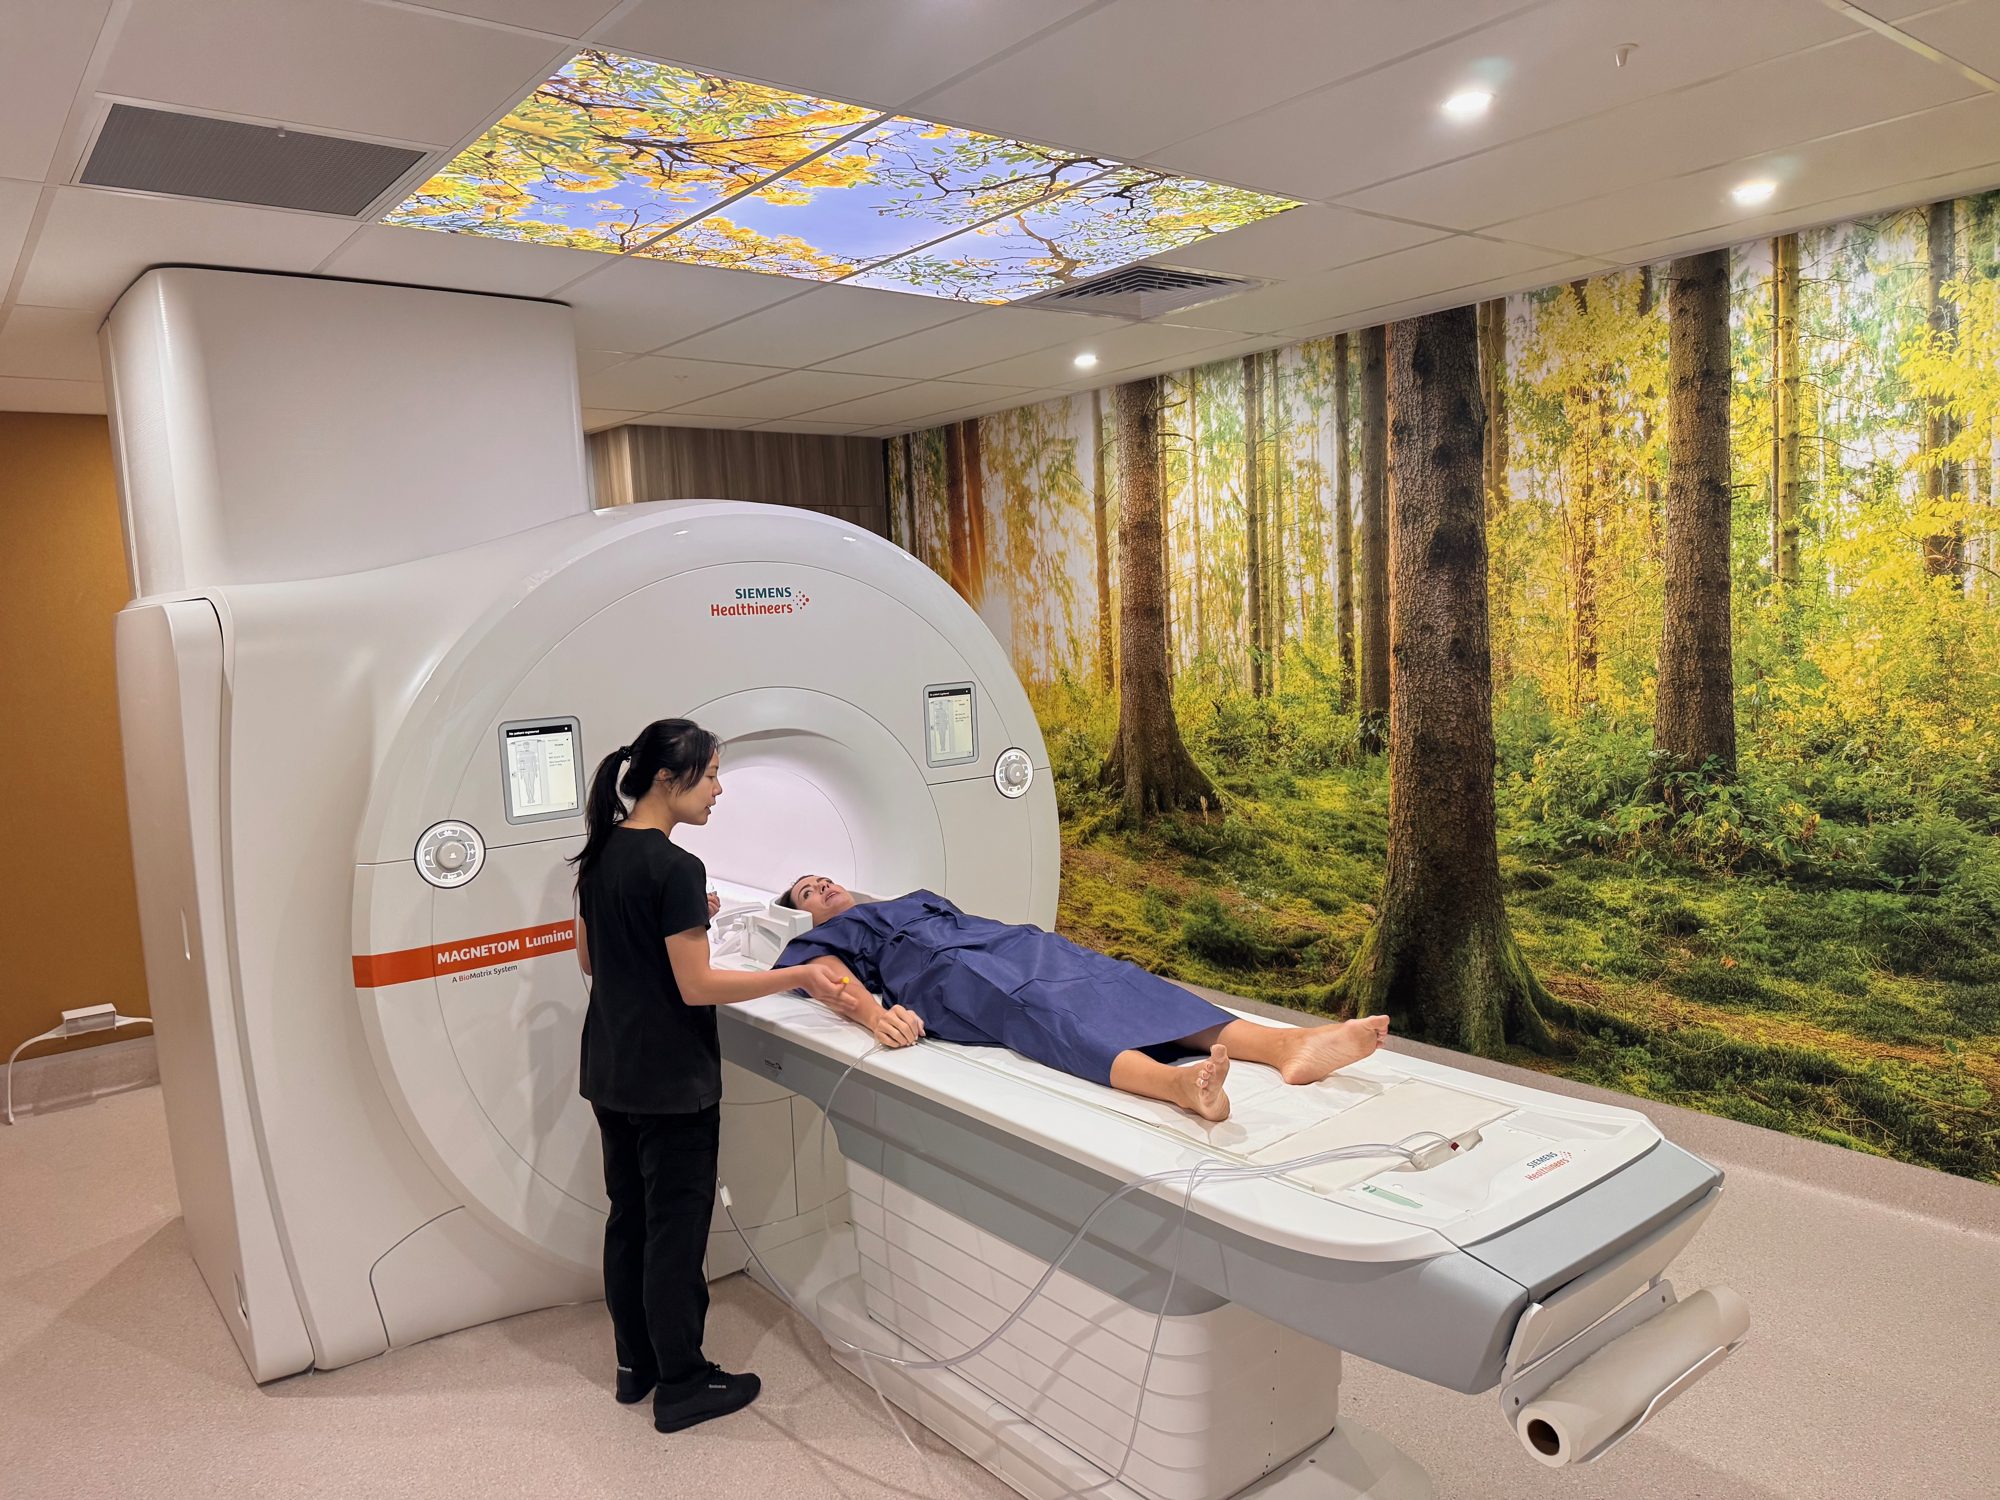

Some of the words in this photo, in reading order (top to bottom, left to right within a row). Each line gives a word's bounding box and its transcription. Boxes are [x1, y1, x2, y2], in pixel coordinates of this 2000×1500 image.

[735, 587, 791, 599] SIEMENS
[711, 601, 793, 616] Healthineers
[437, 939, 520, 965] MAGNETOM
[525, 929, 574, 948] Lumina
[458, 969, 492, 982] BioMatrix
[493, 964, 518, 976] System
[1526, 1151, 1558, 1168] SIEMENS
[1524, 1158, 1570, 1181] Healthineers
